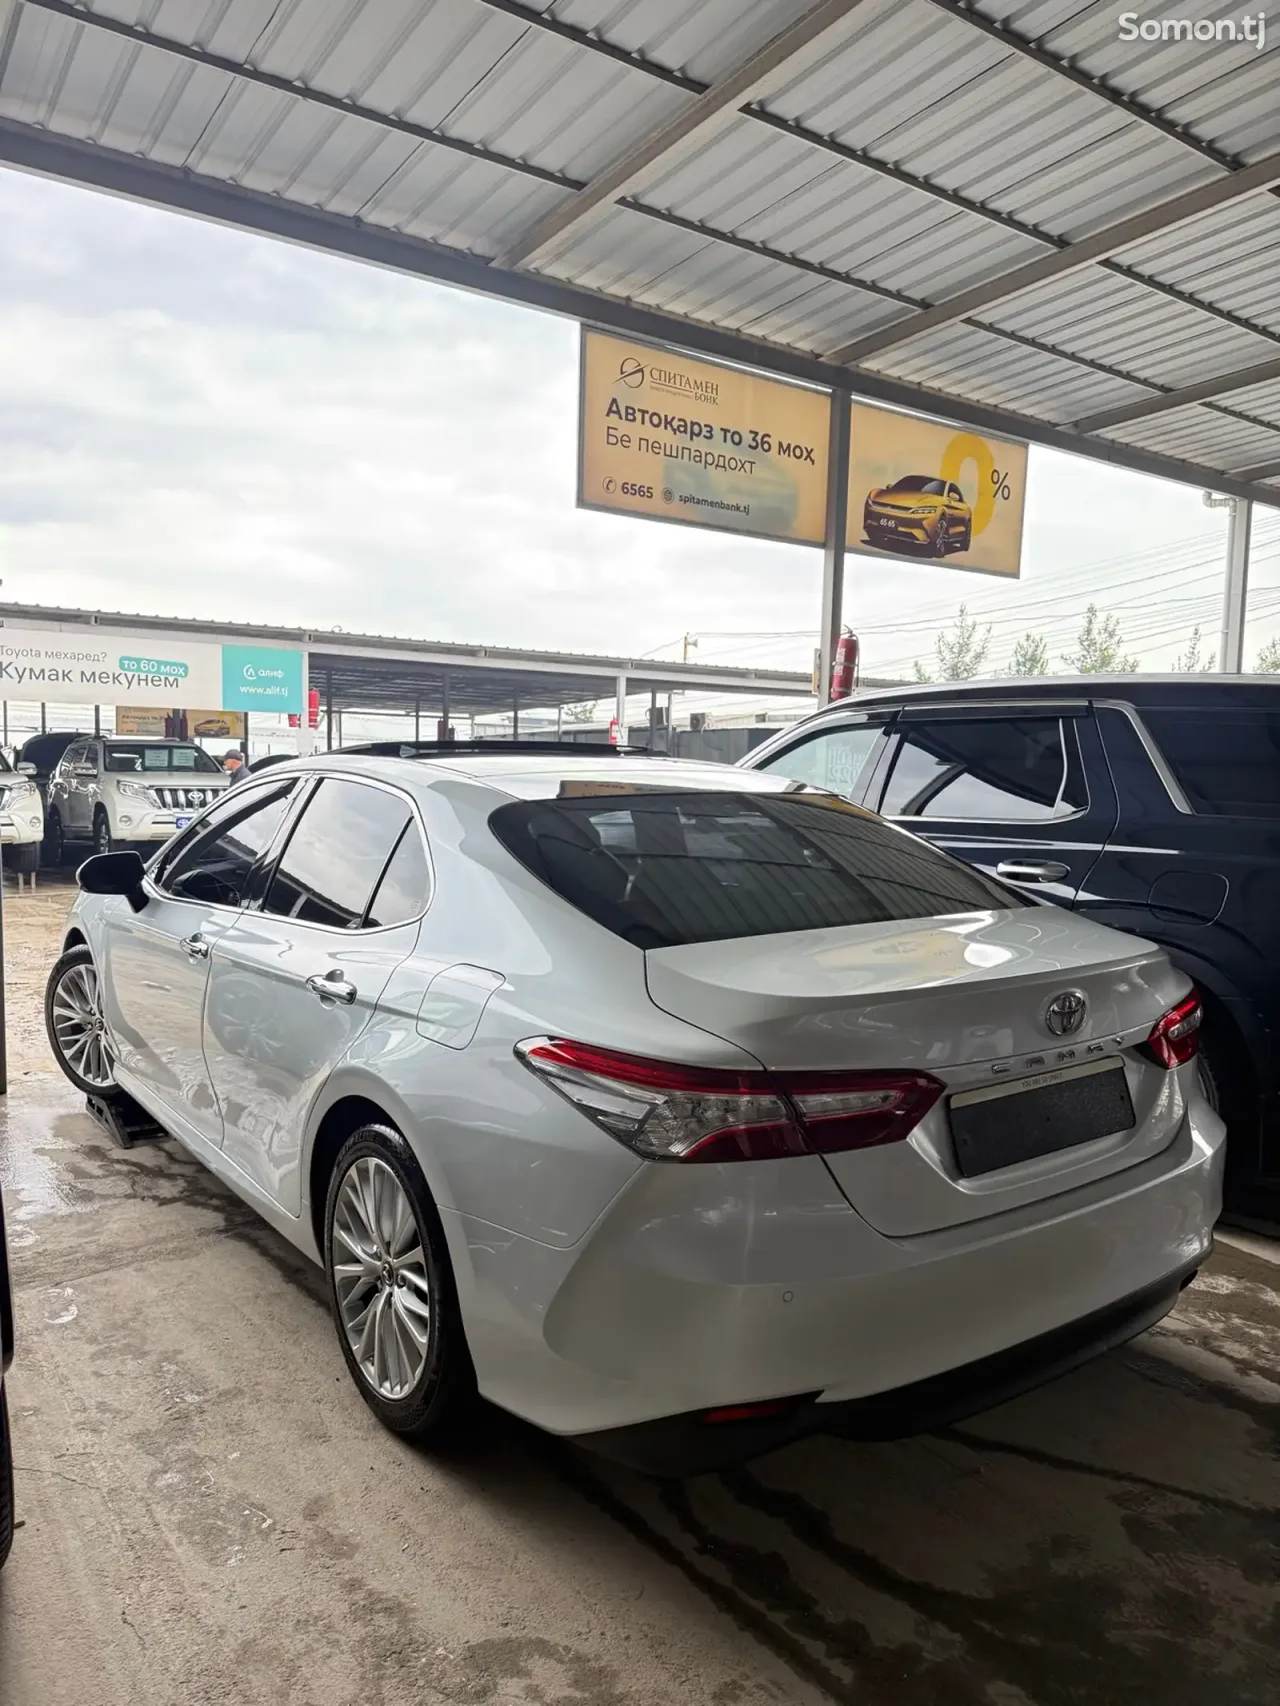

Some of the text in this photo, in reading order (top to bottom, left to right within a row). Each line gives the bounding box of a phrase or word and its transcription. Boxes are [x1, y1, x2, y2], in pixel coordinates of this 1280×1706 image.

[650, 367, 719, 396] СПИТАМЕН
[694, 391, 719, 406] БОНК
[605, 397, 714, 441] Автоқарз
[720, 427, 743, 446] то
[748, 430, 772, 453] 36
[606, 426, 756, 475] Бе пешпардохт
[621, 481, 654, 499] 6565
[678, 493, 751, 516] spitamenbank.tj
[0, 645, 108, 662] Toyota мехаред?
[122, 659, 137, 669] то
[140, 659, 158, 672] 60
[258, 668, 285, 679] алиф
[0, 660, 180, 690] Кумак мекунем
[239, 685, 288, 697] www.alif.tj
